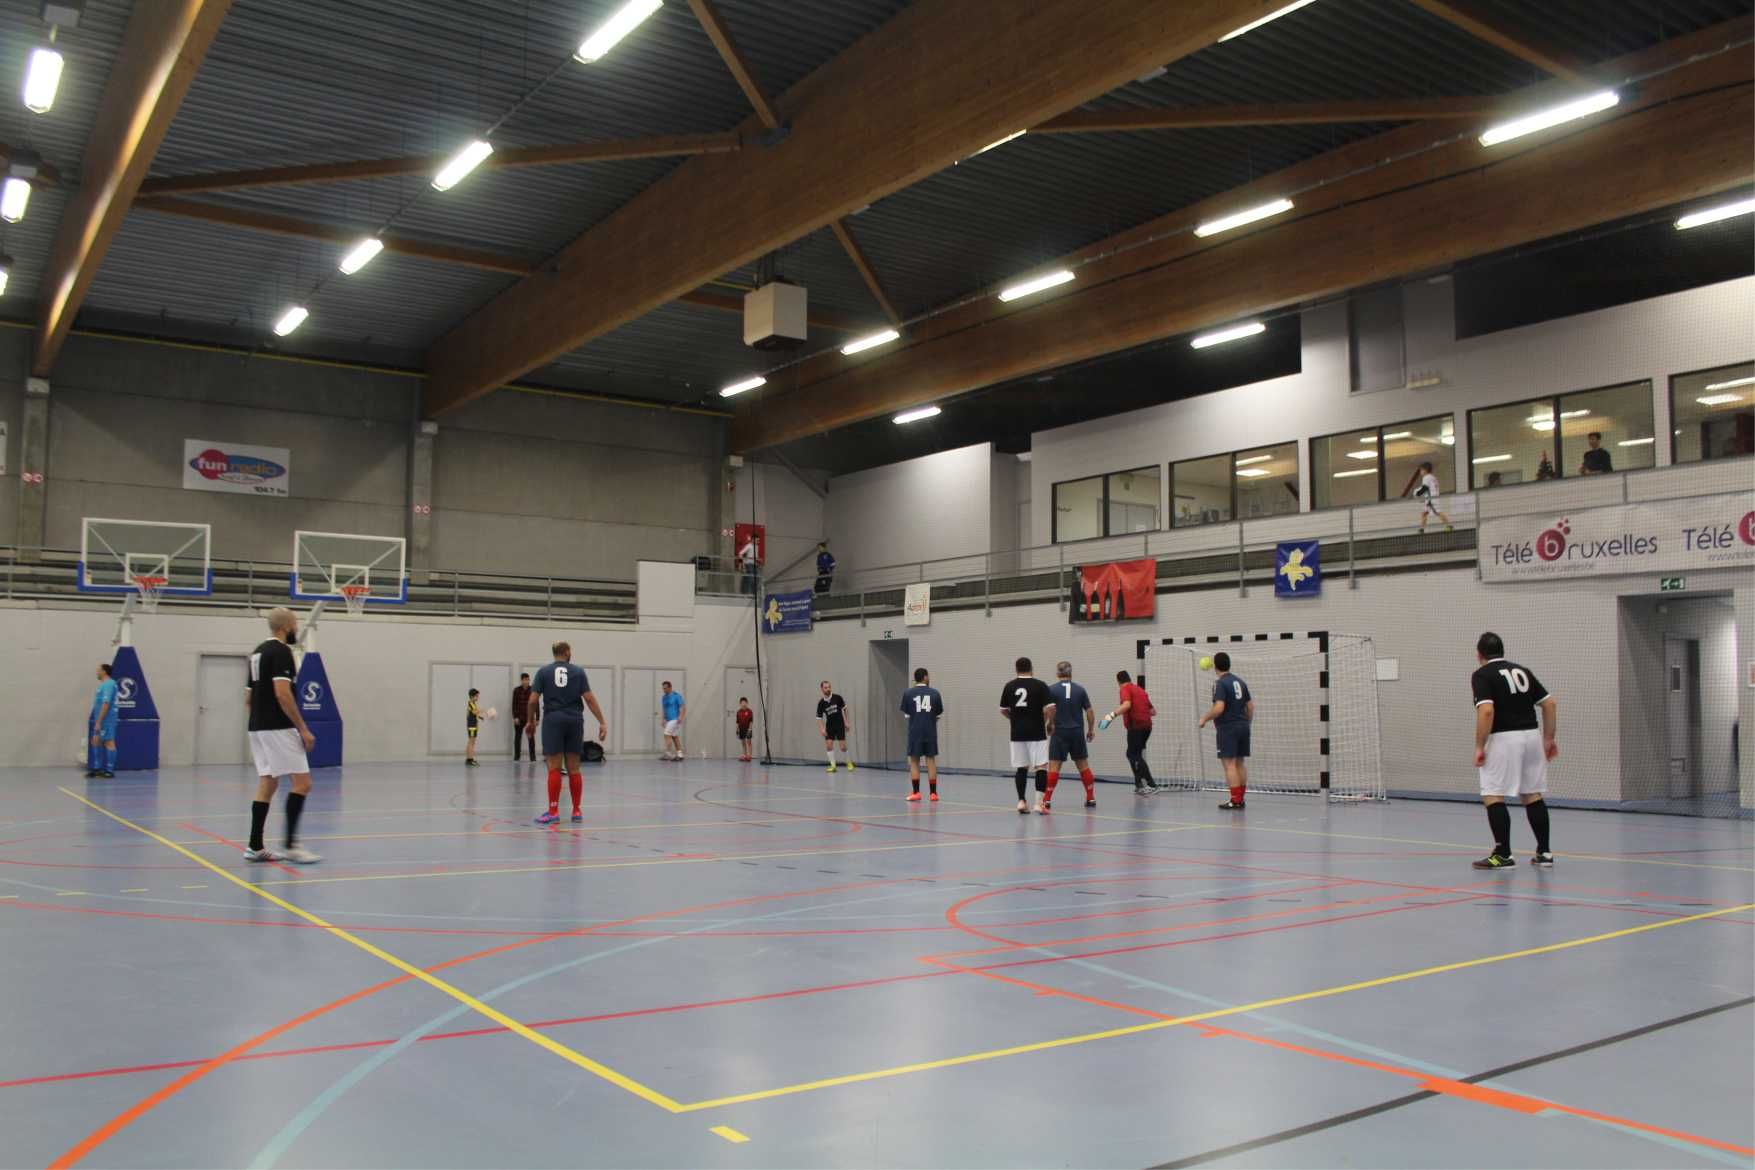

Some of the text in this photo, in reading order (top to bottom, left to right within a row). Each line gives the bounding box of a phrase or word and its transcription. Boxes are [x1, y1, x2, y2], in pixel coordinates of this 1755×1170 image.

[198, 457, 227, 472] fun
[1682, 524, 1734, 551] Télé
[1491, 542, 1533, 565] Télé
[554, 666, 568, 688] 6
[1498, 668, 1529, 694] 10
[1014, 687, 1028, 707] 2
[1232, 680, 1243, 700] 9
[913, 695, 932, 713] 14
